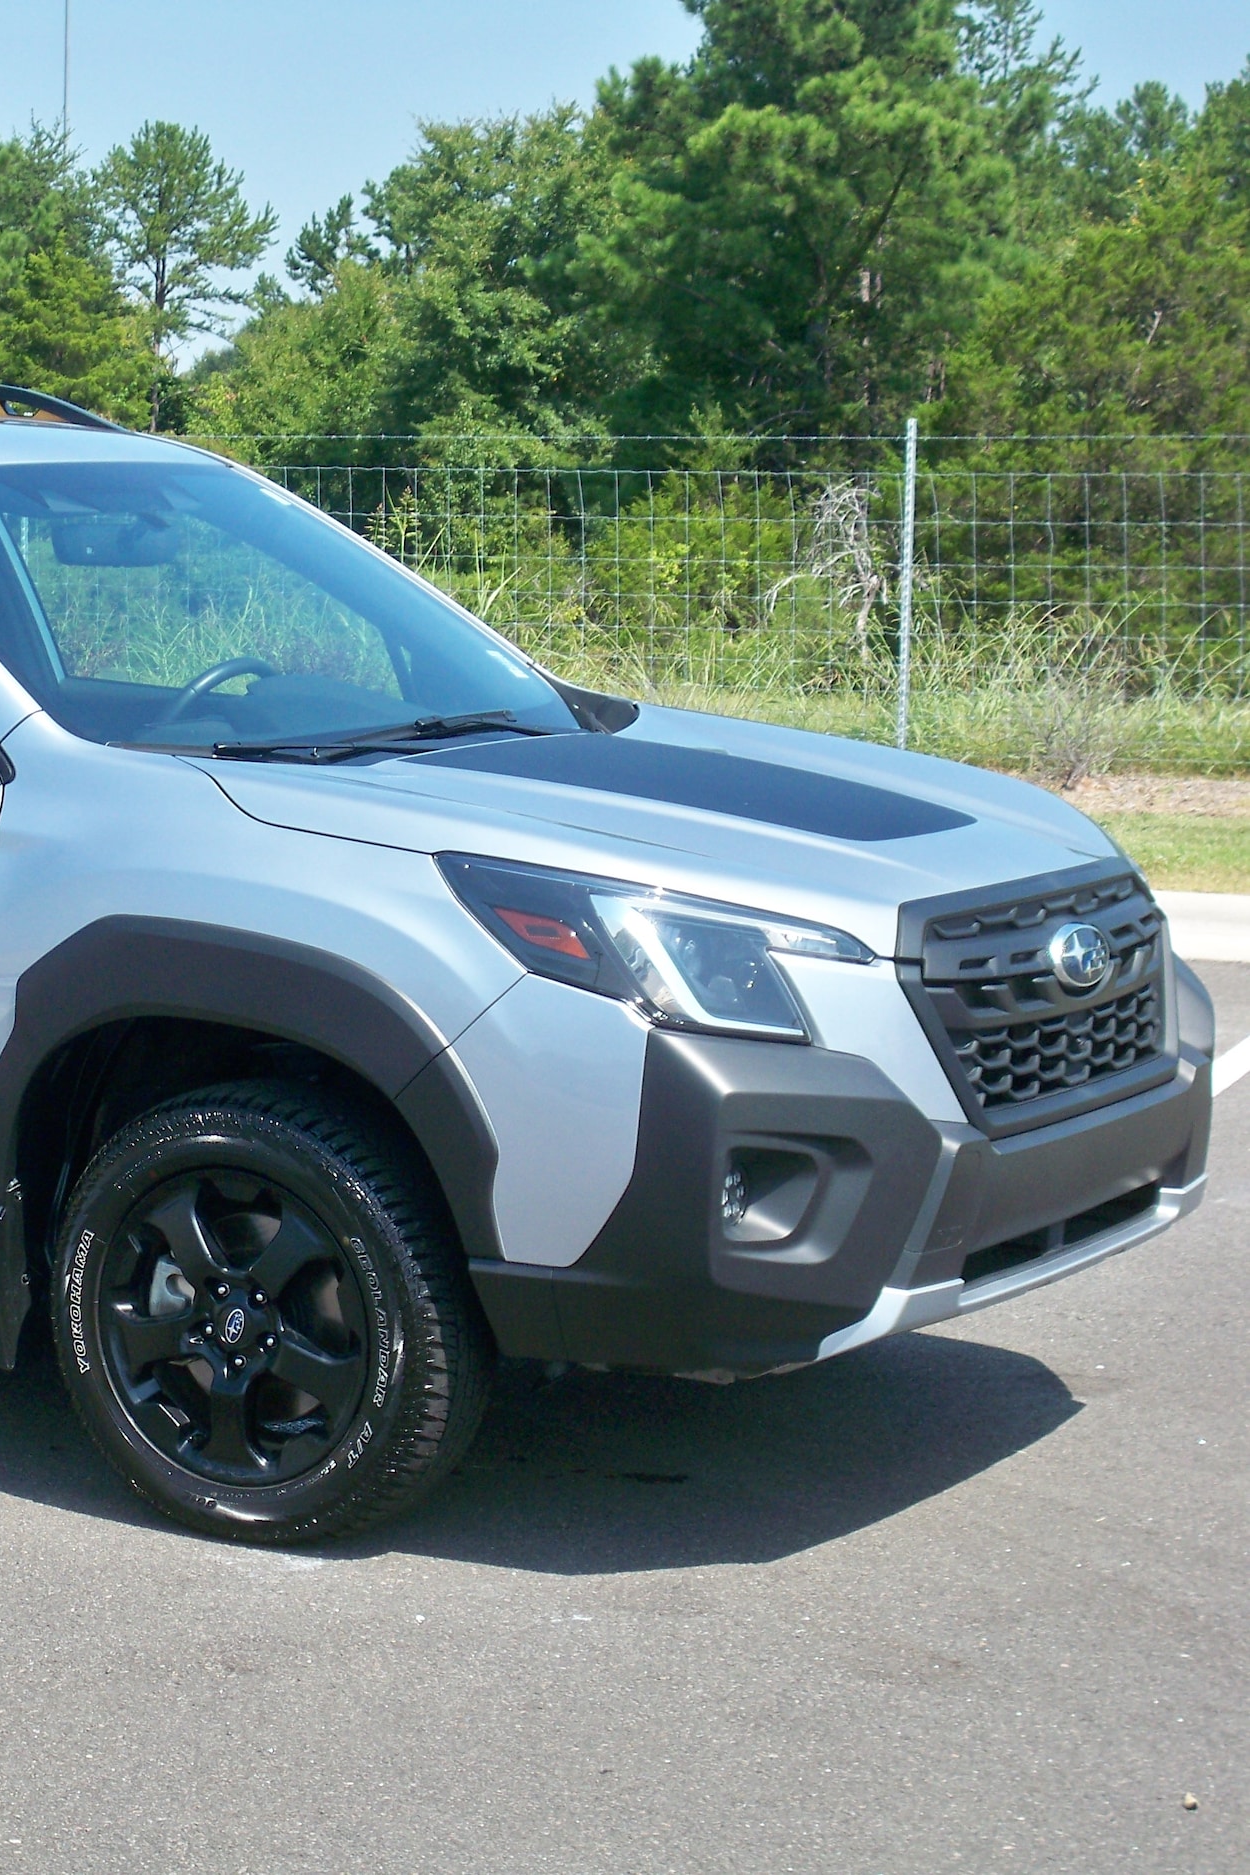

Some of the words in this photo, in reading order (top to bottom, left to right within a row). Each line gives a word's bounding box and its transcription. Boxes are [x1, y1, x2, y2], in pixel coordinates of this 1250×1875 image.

[70, 1229, 95, 1374] YOKOHAMA
[350, 1237, 390, 1408] GEOLANDAR
[347, 1421, 373, 1469] A/T
